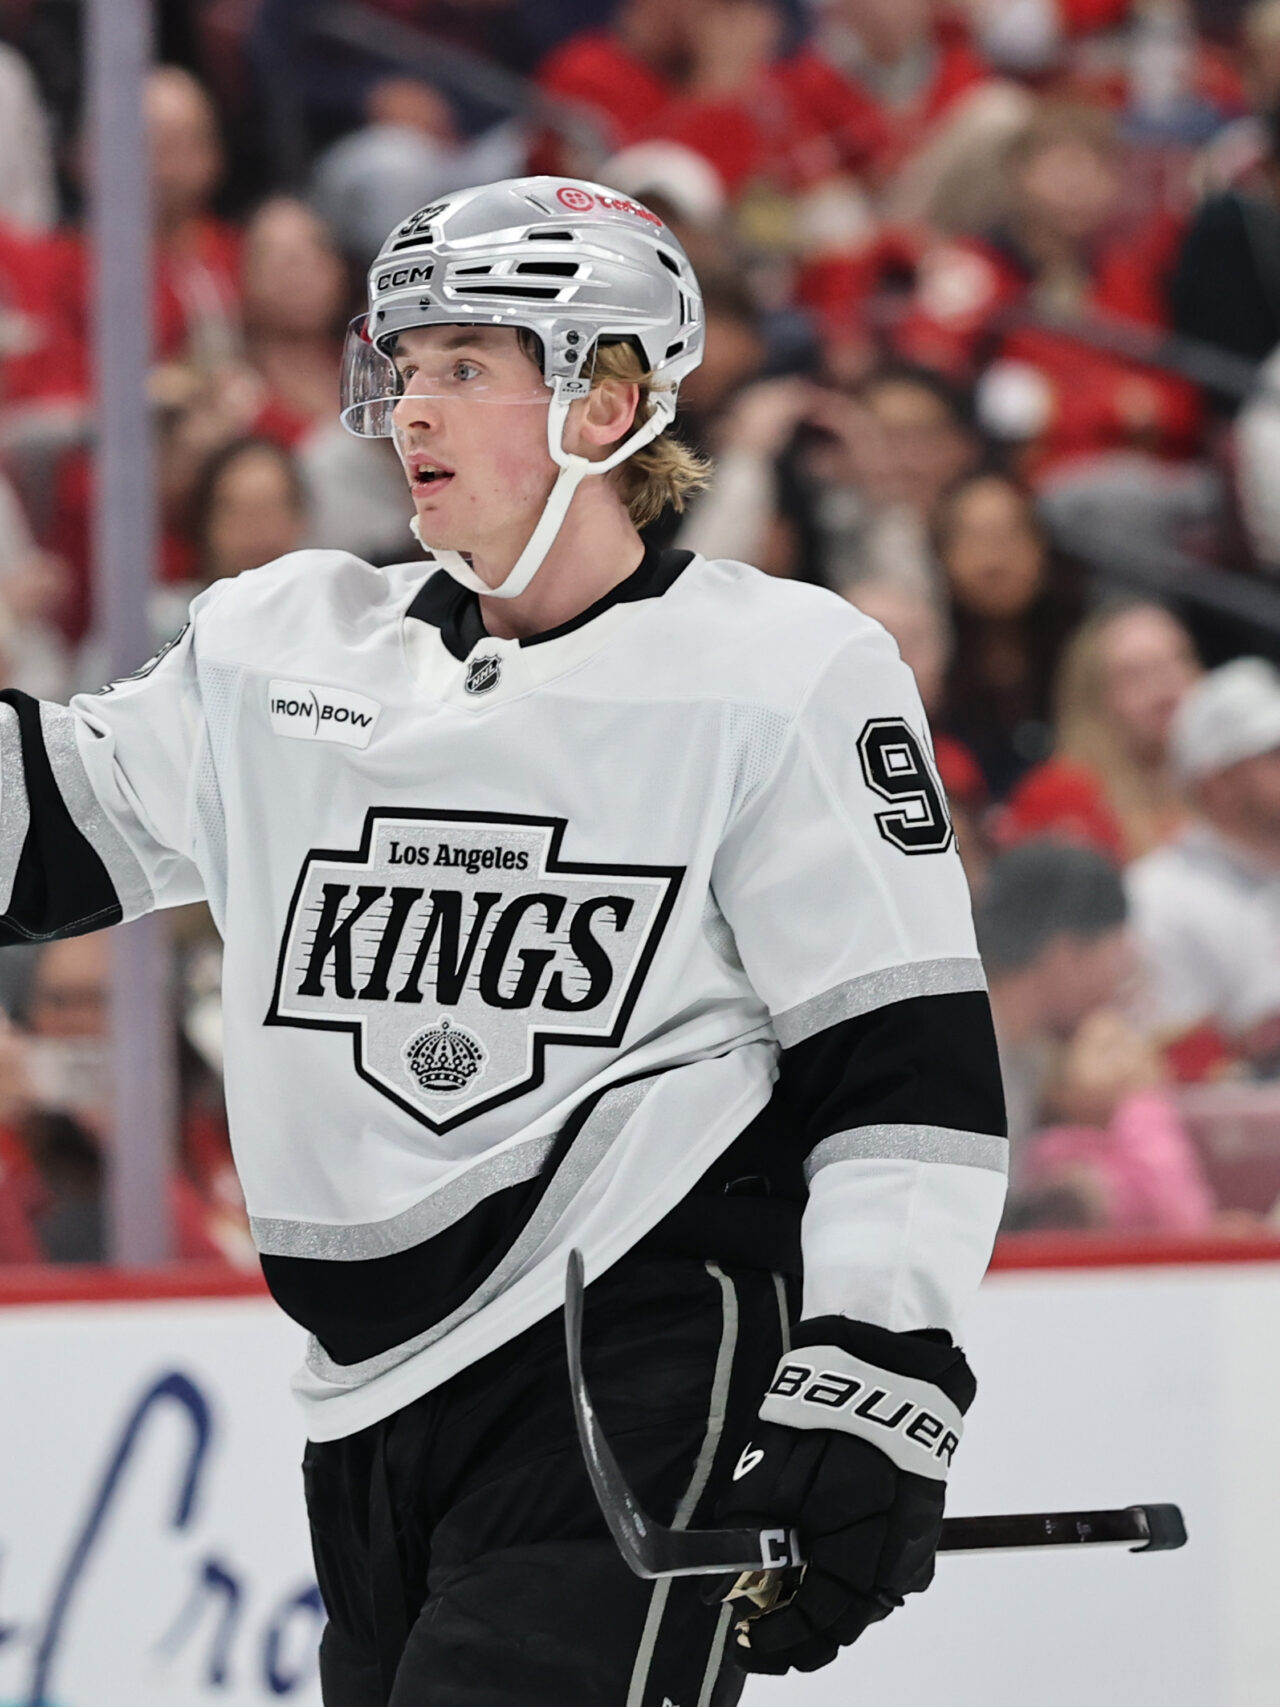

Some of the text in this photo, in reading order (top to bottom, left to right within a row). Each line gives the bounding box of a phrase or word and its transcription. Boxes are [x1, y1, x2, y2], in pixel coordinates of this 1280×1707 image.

[376, 265, 435, 291] CCM
[271, 699, 373, 728] IRON BOW
[855, 716, 959, 856] 9
[388, 841, 529, 874] Los Angeles
[296, 883, 635, 1013] KINGS
